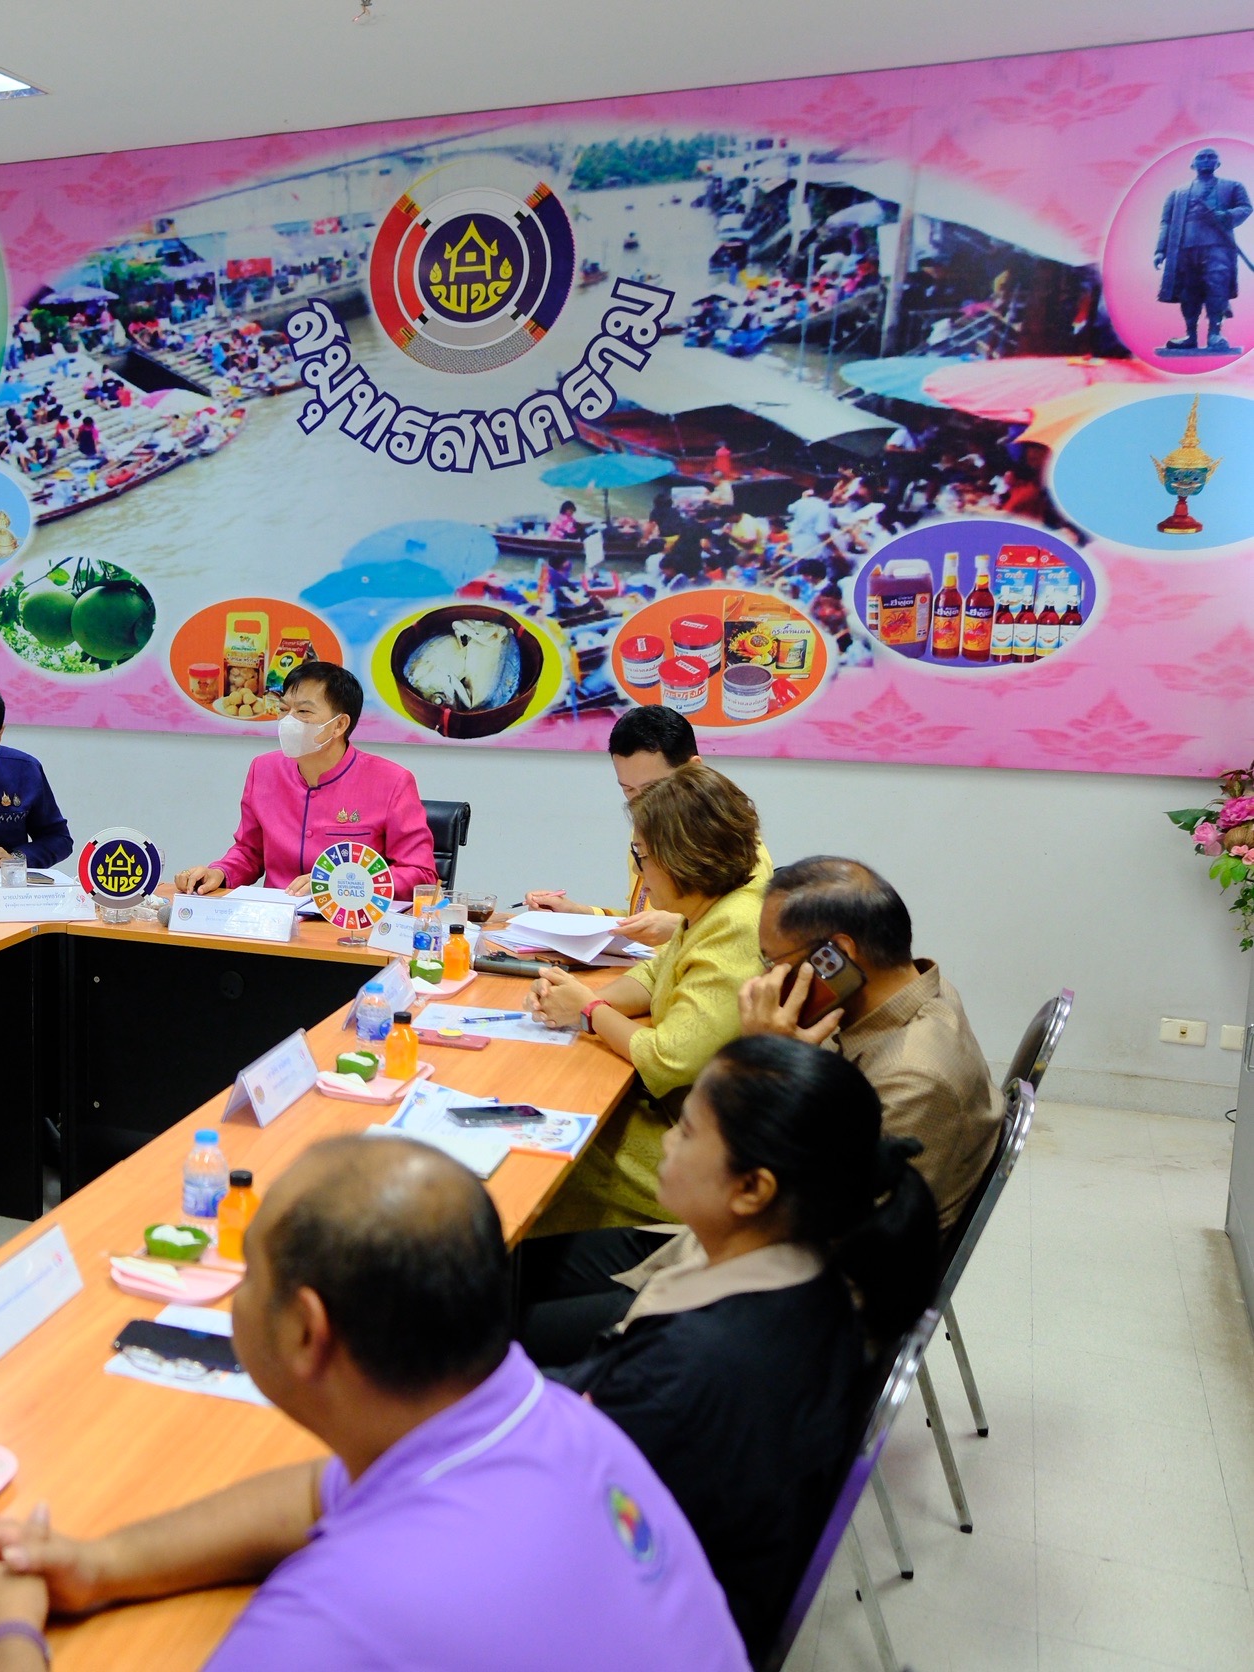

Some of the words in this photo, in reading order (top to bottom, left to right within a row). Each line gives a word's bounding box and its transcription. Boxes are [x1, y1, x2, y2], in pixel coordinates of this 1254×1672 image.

[286, 277, 676, 474] สมุทรสงคราม
[337, 889, 366, 898] GOALS
